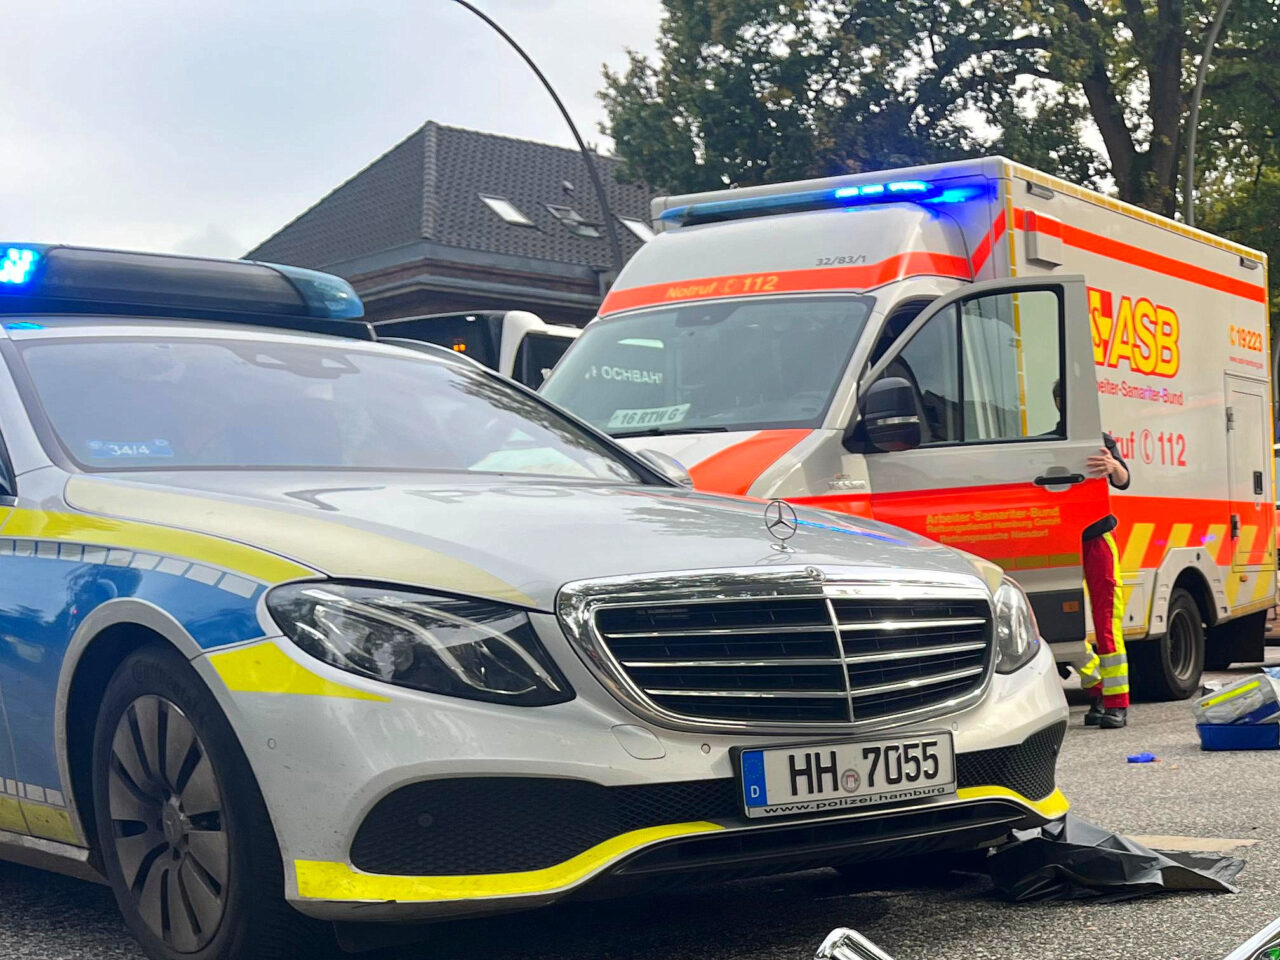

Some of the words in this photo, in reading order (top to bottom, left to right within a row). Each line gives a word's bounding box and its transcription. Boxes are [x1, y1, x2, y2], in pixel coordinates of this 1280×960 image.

[815, 255, 867, 266] 32/83/1
[666, 281, 718, 299] Notruf
[742, 276, 779, 292] 112
[1107, 295, 1180, 379] ASB
[620, 412, 637, 425] 16
[637, 409, 667, 424] RTW
[1158, 432, 1187, 467] 112
[751, 785, 760, 798] D
[788, 751, 839, 796] HH
[862, 740, 939, 788] 7055
[764, 786, 946, 815] www.polizei.hamburg
